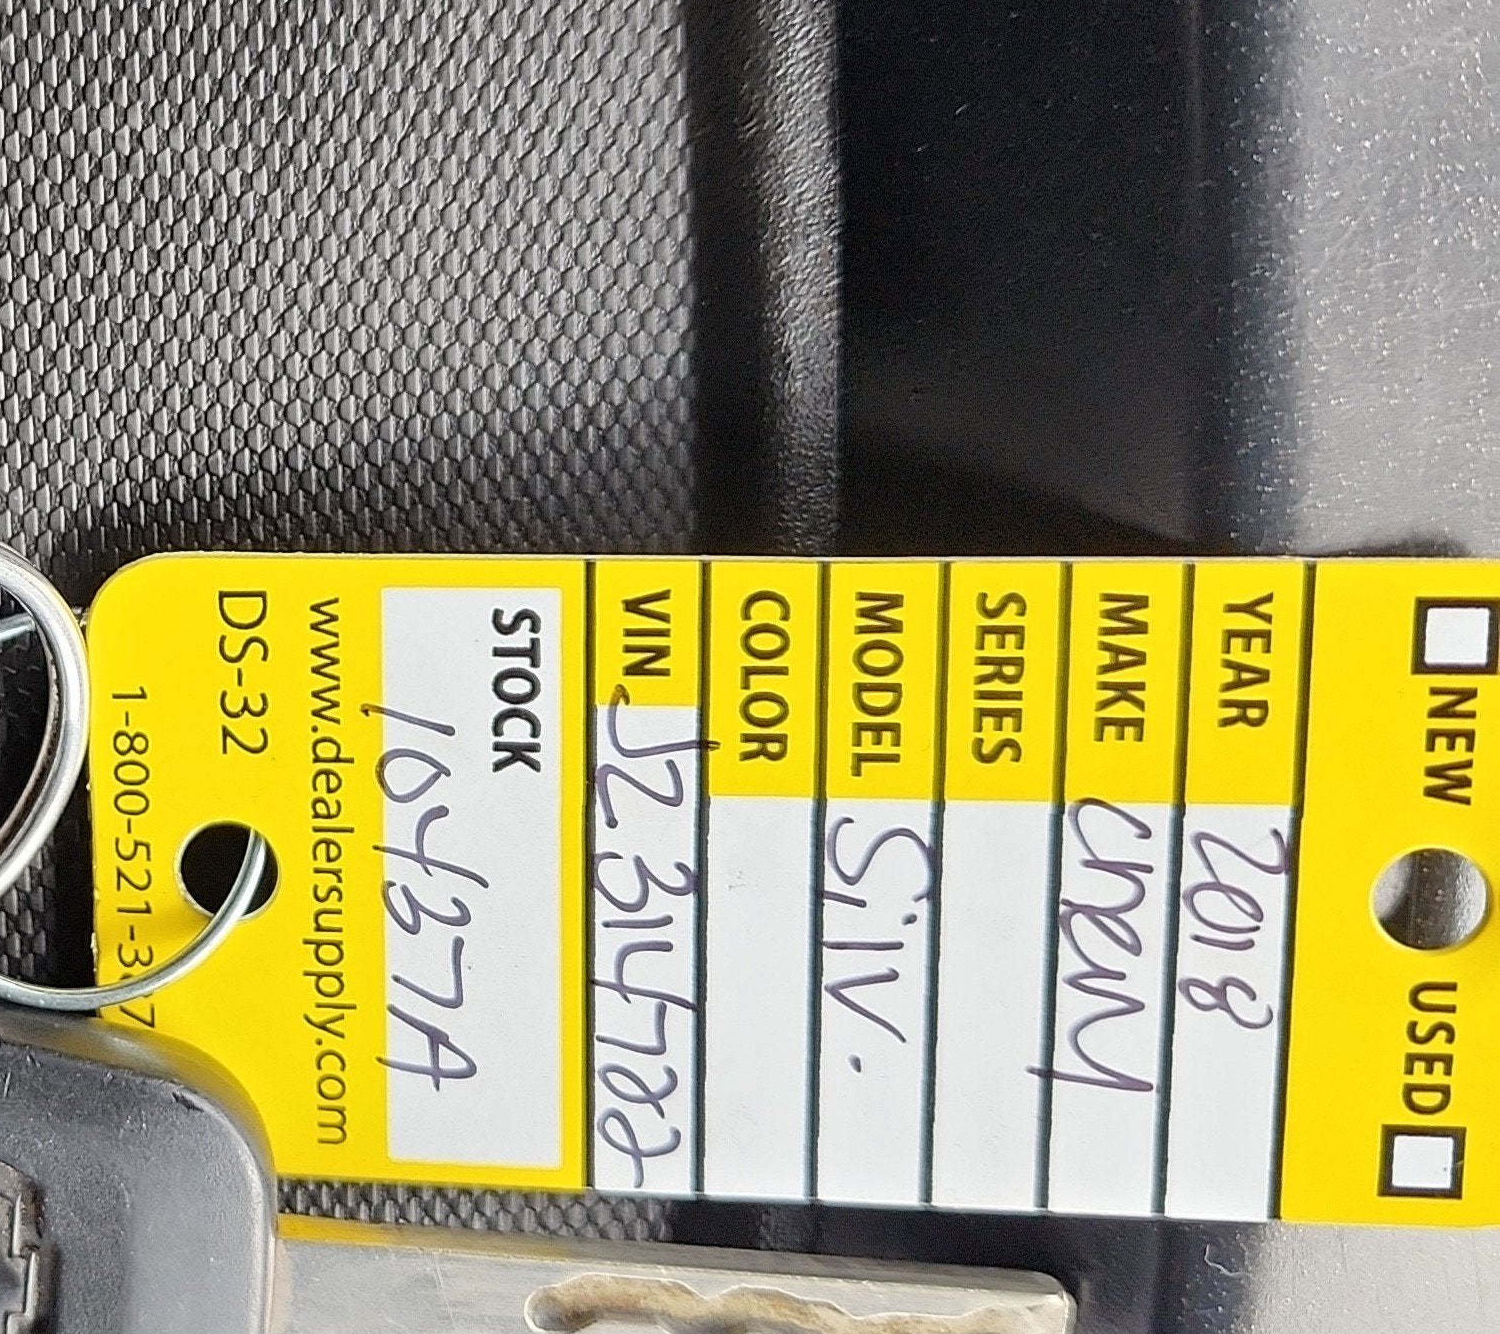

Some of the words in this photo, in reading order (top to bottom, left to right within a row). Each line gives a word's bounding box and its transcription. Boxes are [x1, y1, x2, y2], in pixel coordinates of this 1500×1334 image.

[217, 590, 268, 755] DS-32
[490, 608, 540, 773] STOCK
[622, 590, 671, 677] VIN
[739, 590, 789, 762] COLOR
[850, 591, 903, 776] MODEL
[971, 591, 1026, 764] SERIES
[1093, 592, 1149, 742] MAKE
[1217, 592, 1273, 728] YEAR
[1422, 685, 1477, 806] NEW
[111, 686, 154, 1030] 1-800-521-37
[300, 598, 356, 1145] www.dealersupply.com
[360, 703, 488, 1091] 10437A
[1178, 829, 1291, 1028] 2018
[1401, 982, 1457, 1115] USED
